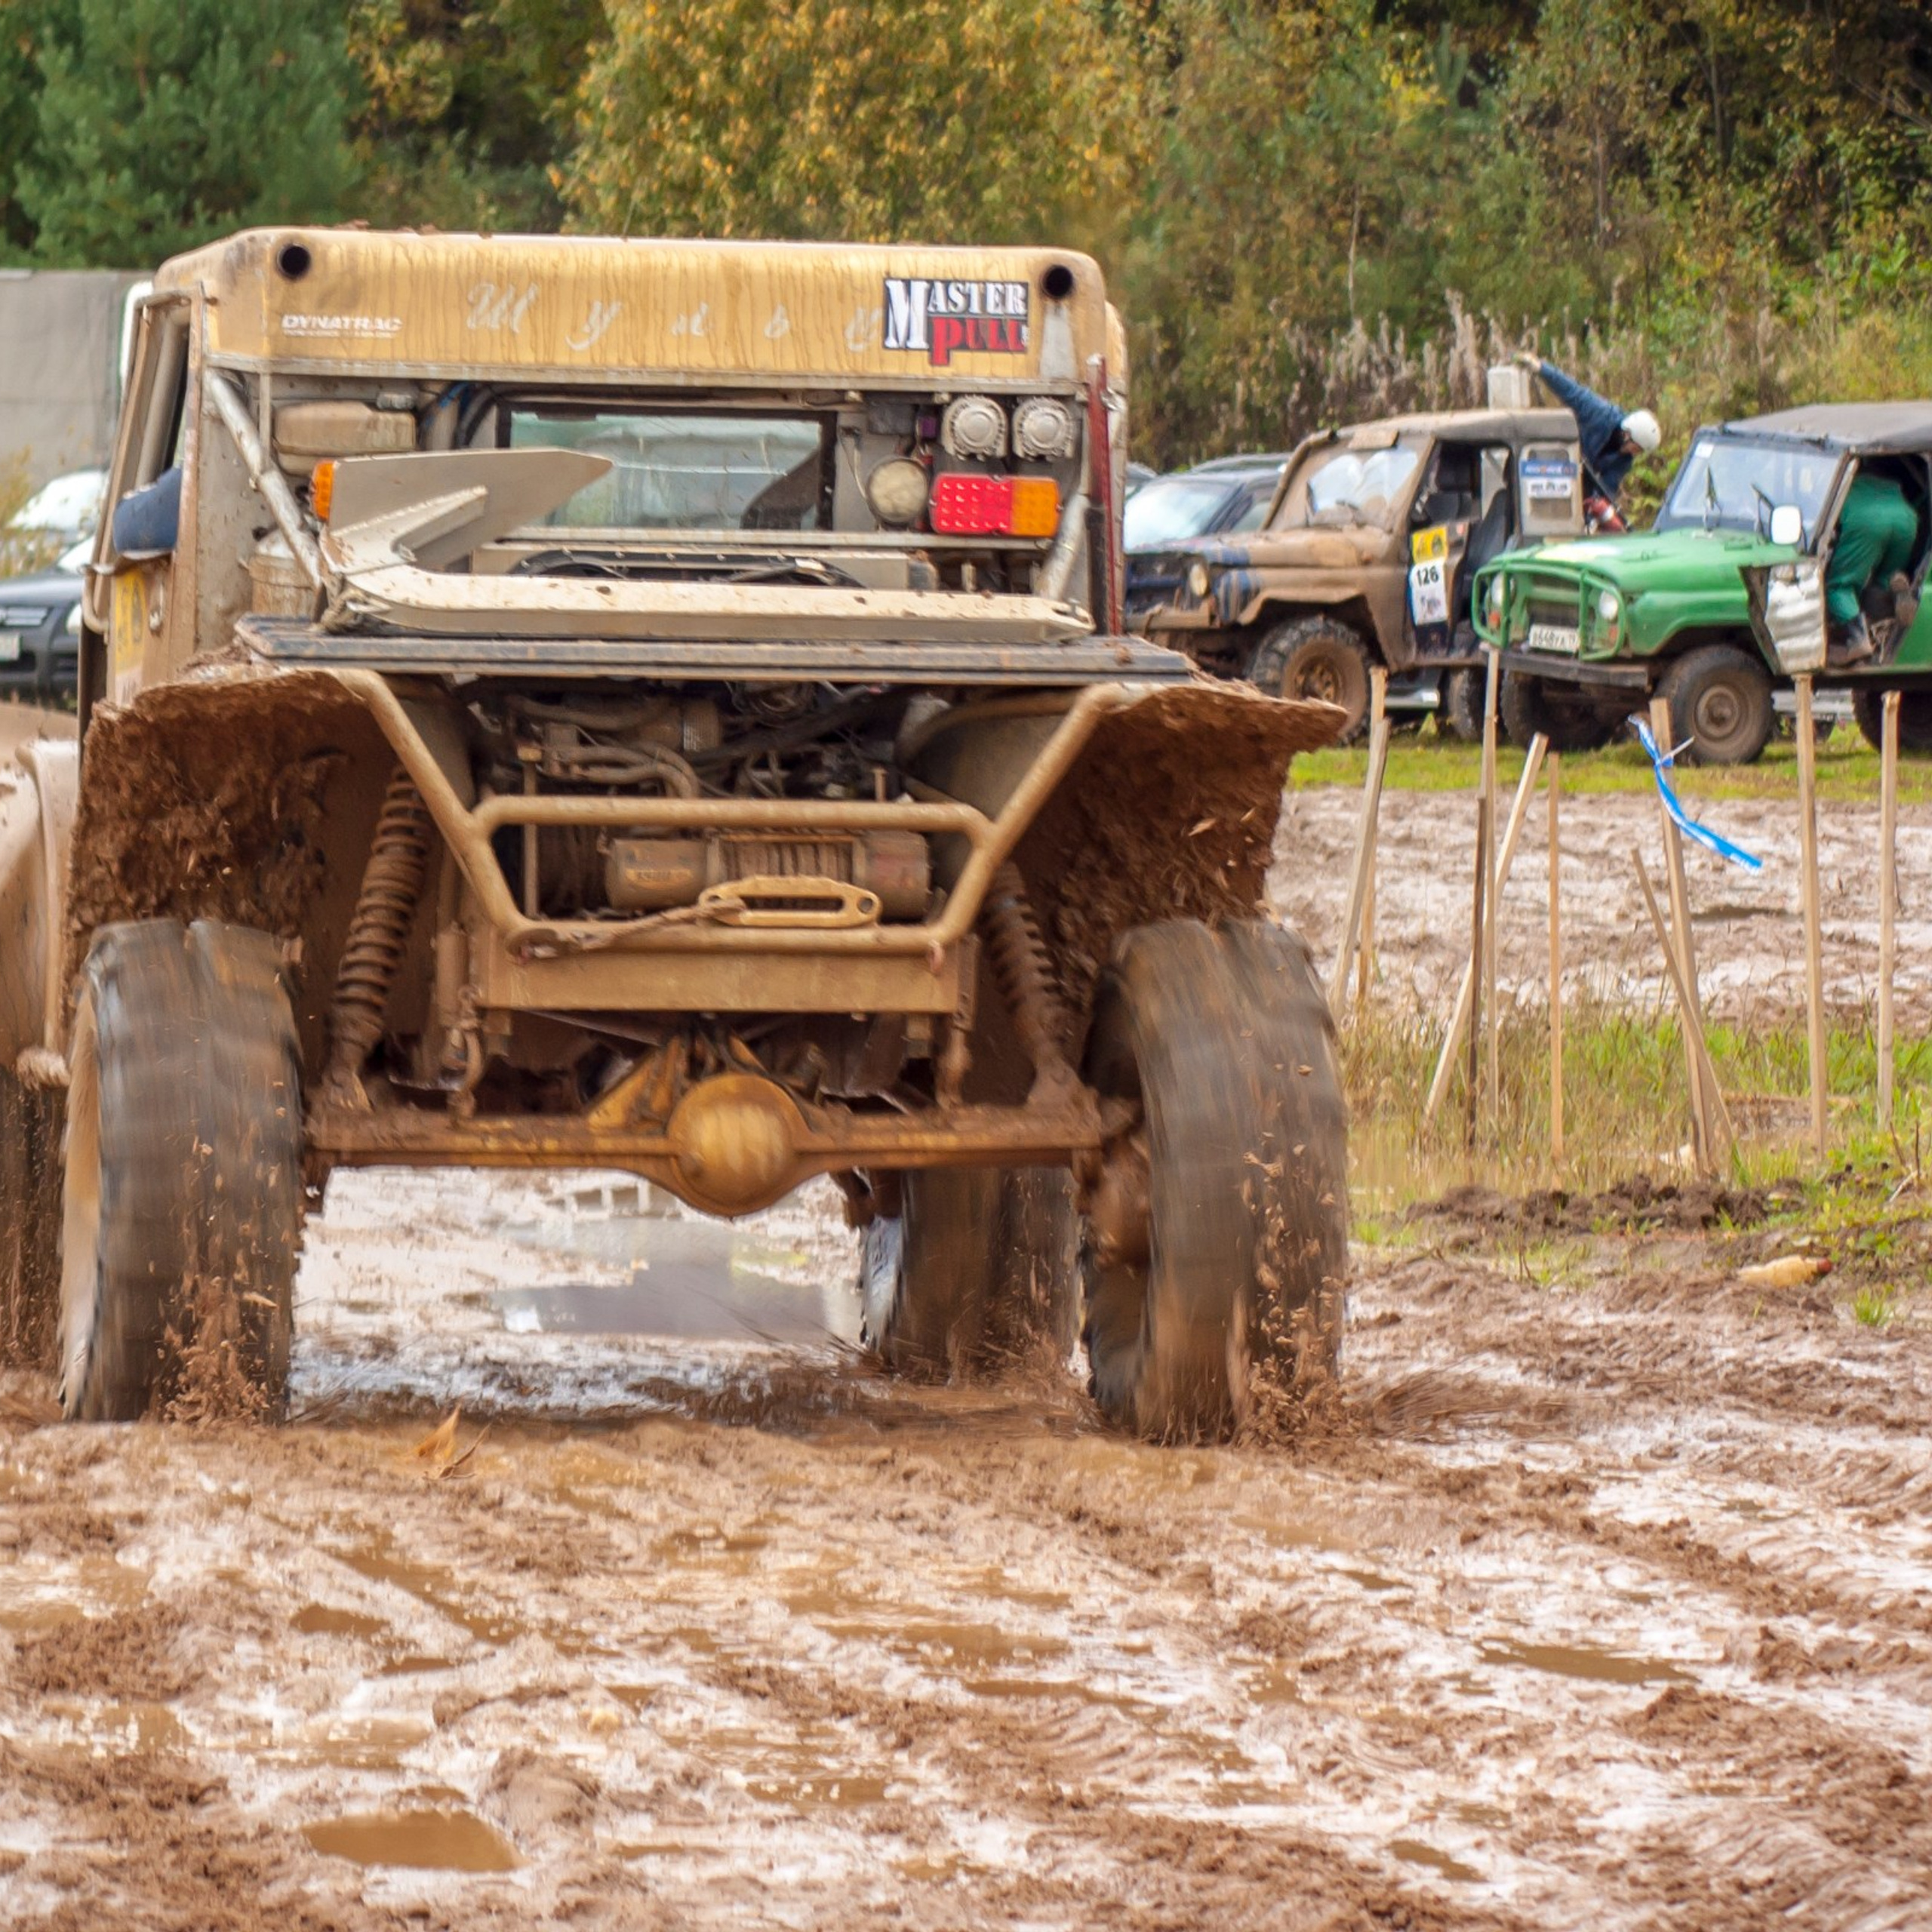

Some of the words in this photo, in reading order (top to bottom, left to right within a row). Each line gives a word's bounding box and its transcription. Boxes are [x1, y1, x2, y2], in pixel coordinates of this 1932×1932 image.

[281, 313, 403, 332] DYNATRAC
[884, 279, 1027, 349] MASTER
[1417, 565, 1439, 587] 126
